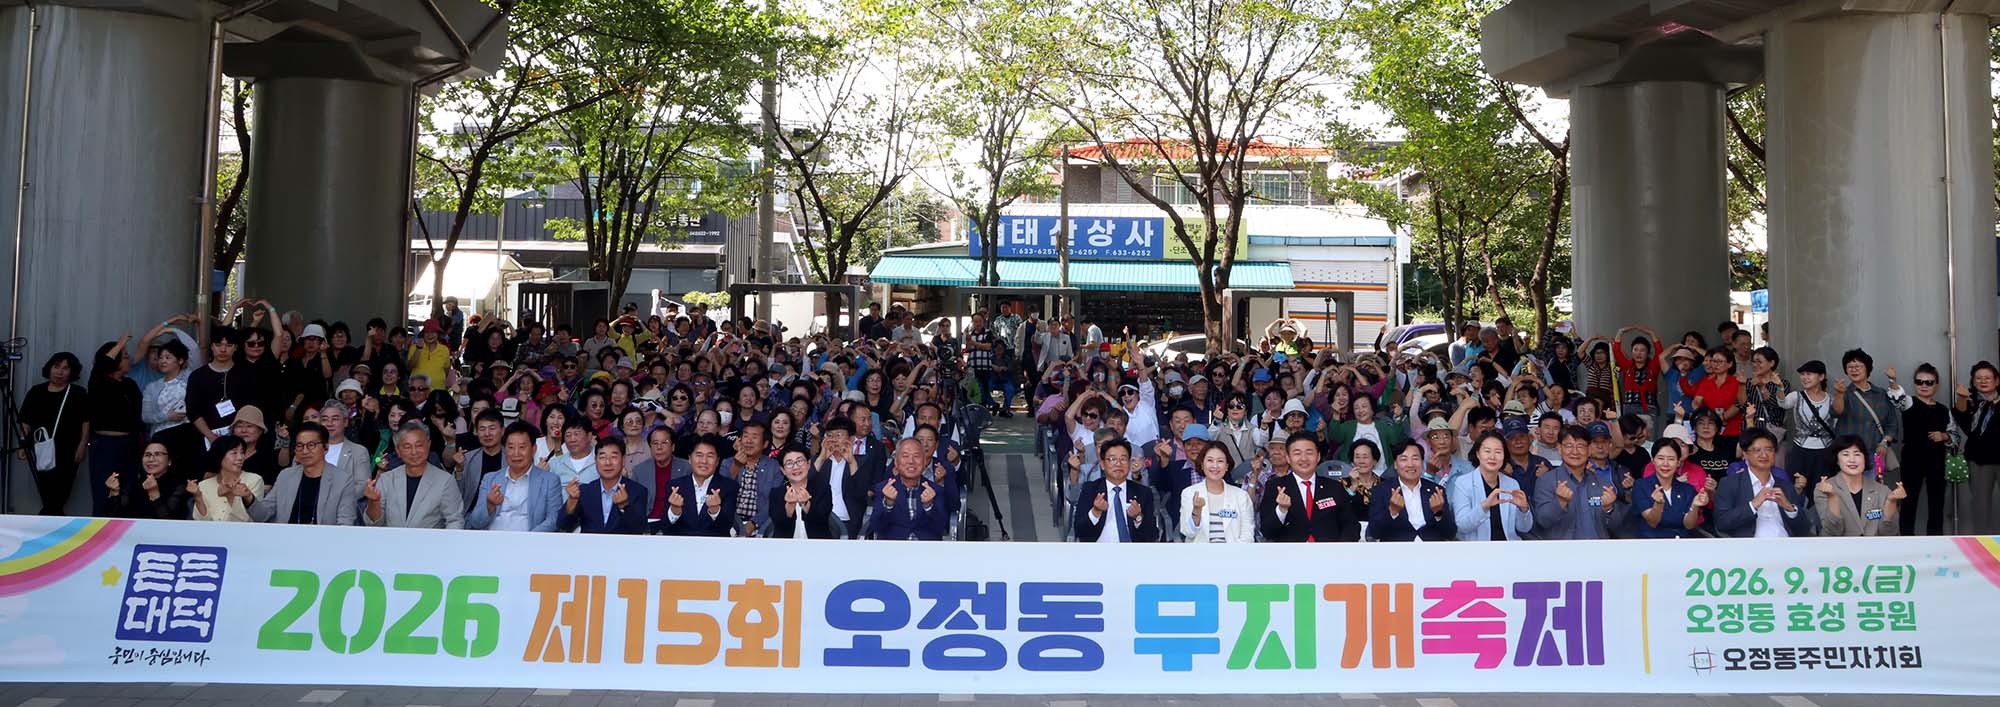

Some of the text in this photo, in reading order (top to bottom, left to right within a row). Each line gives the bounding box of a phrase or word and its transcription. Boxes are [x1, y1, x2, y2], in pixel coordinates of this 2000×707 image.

[978, 218, 1154, 248] 태산상사
[133, 551, 219, 592] 든든
[1685, 565, 1916, 596] 2026. 9. 18.(금)
[124, 596, 213, 637] 대덕
[257, 569, 1606, 672] 2026 제15회 오정동 무지개축제
[1686, 600, 1917, 634] 오정동 효성 공원
[1723, 645, 1923, 671] 오정동주민자치회
